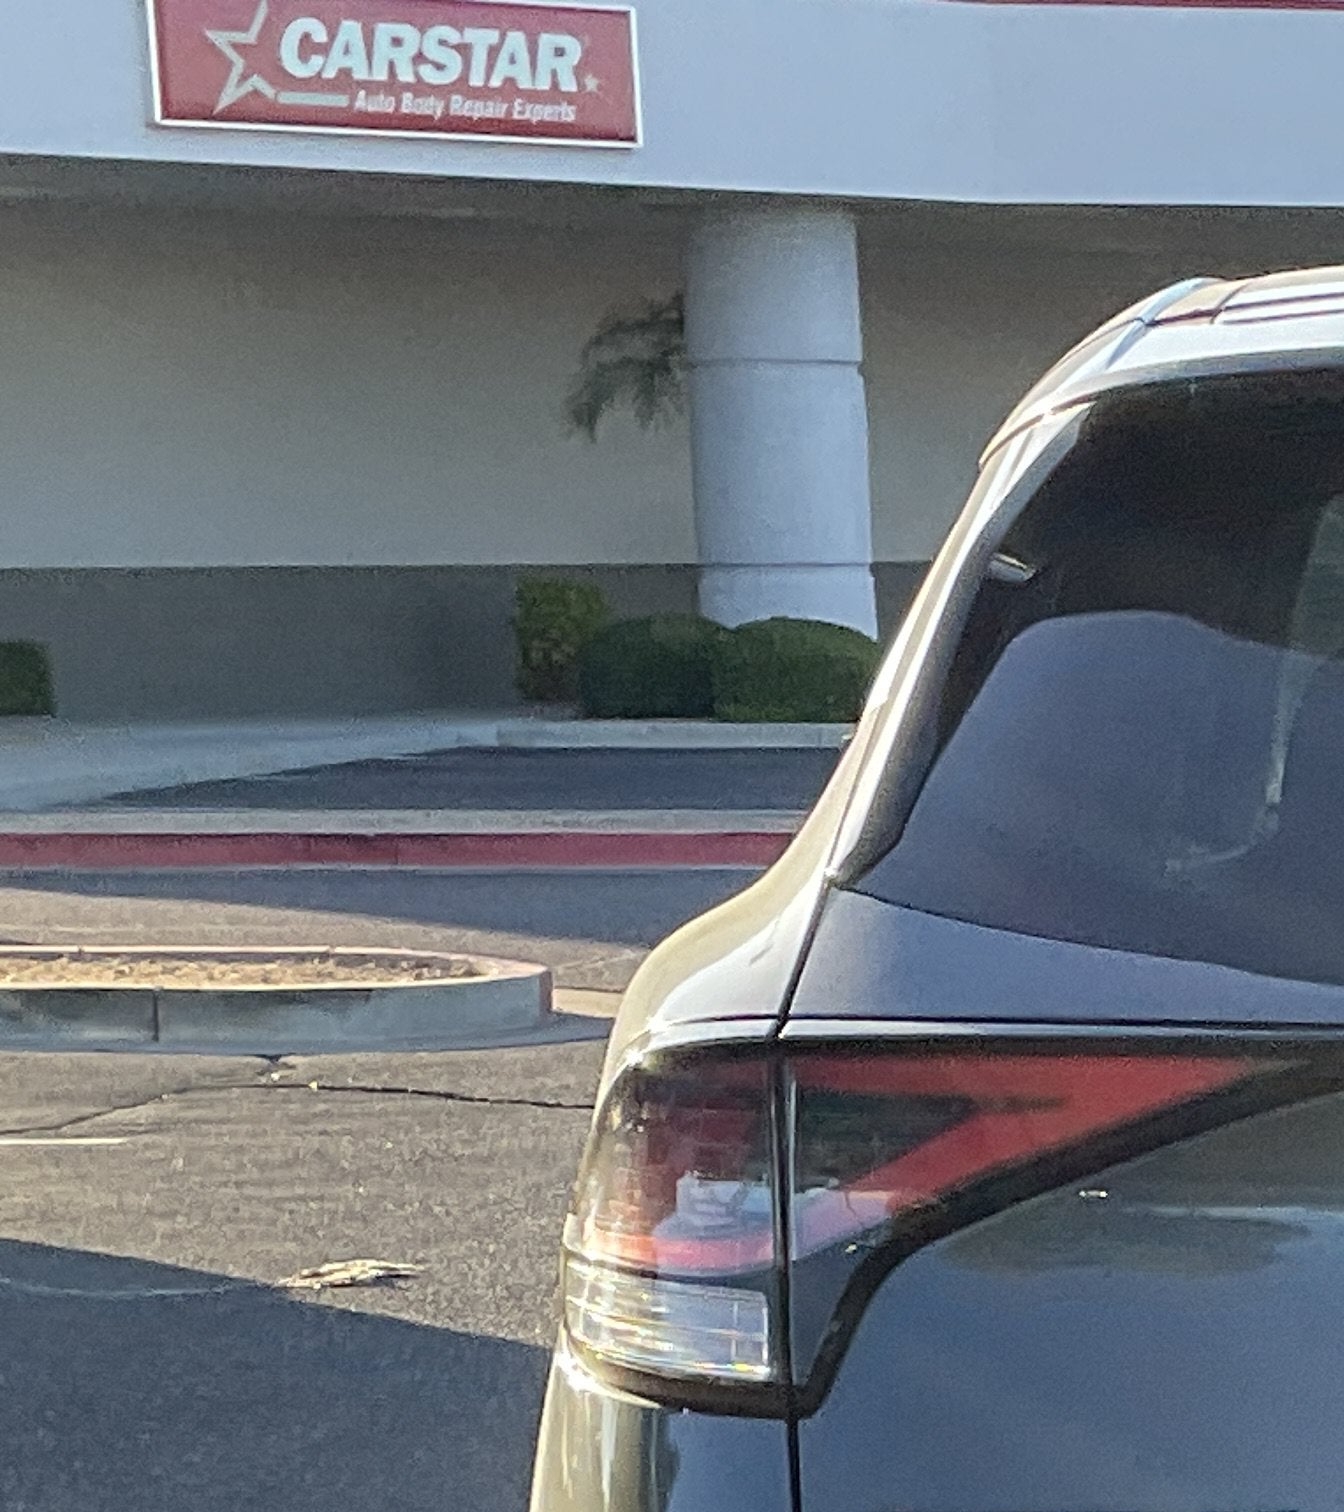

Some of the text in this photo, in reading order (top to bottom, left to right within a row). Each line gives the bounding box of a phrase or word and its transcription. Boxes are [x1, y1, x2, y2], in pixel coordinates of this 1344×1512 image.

[279, 17, 583, 92] CARSTAR
[353, 89, 577, 124] Auto Body Repair Experts
